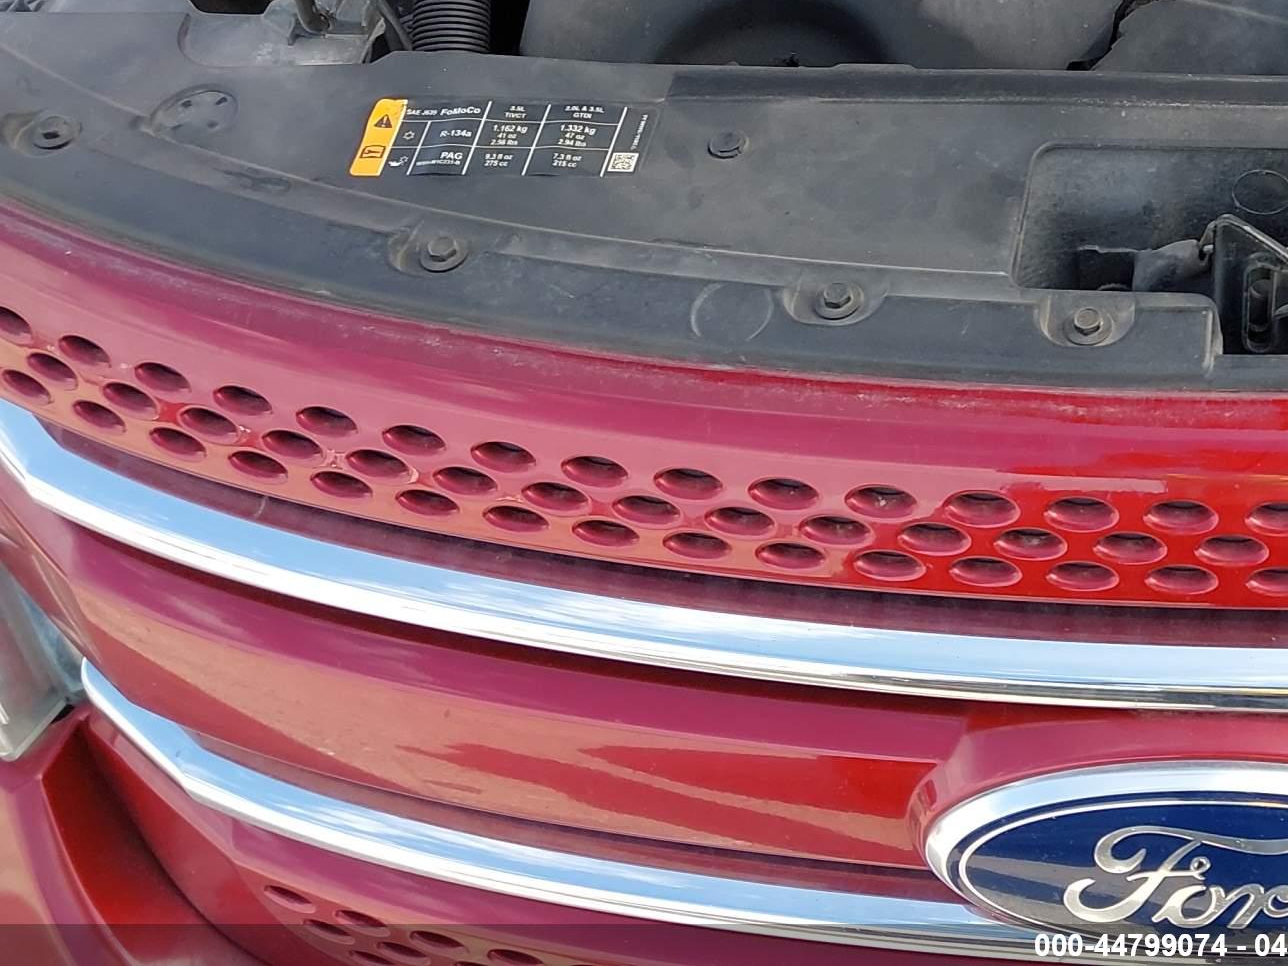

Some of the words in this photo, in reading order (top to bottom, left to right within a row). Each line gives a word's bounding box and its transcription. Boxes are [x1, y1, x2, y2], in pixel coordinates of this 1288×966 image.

[406, 108, 421, 116] SAE
[440, 106, 481, 116] FoMoCo
[440, 129, 472, 138] R-134a
[493, 124, 516, 132] 1.162
[516, 125, 528, 134] kg
[560, 124, 583, 133] 1.332
[584, 126, 597, 135] kg
[440, 151, 463, 160] PAG
